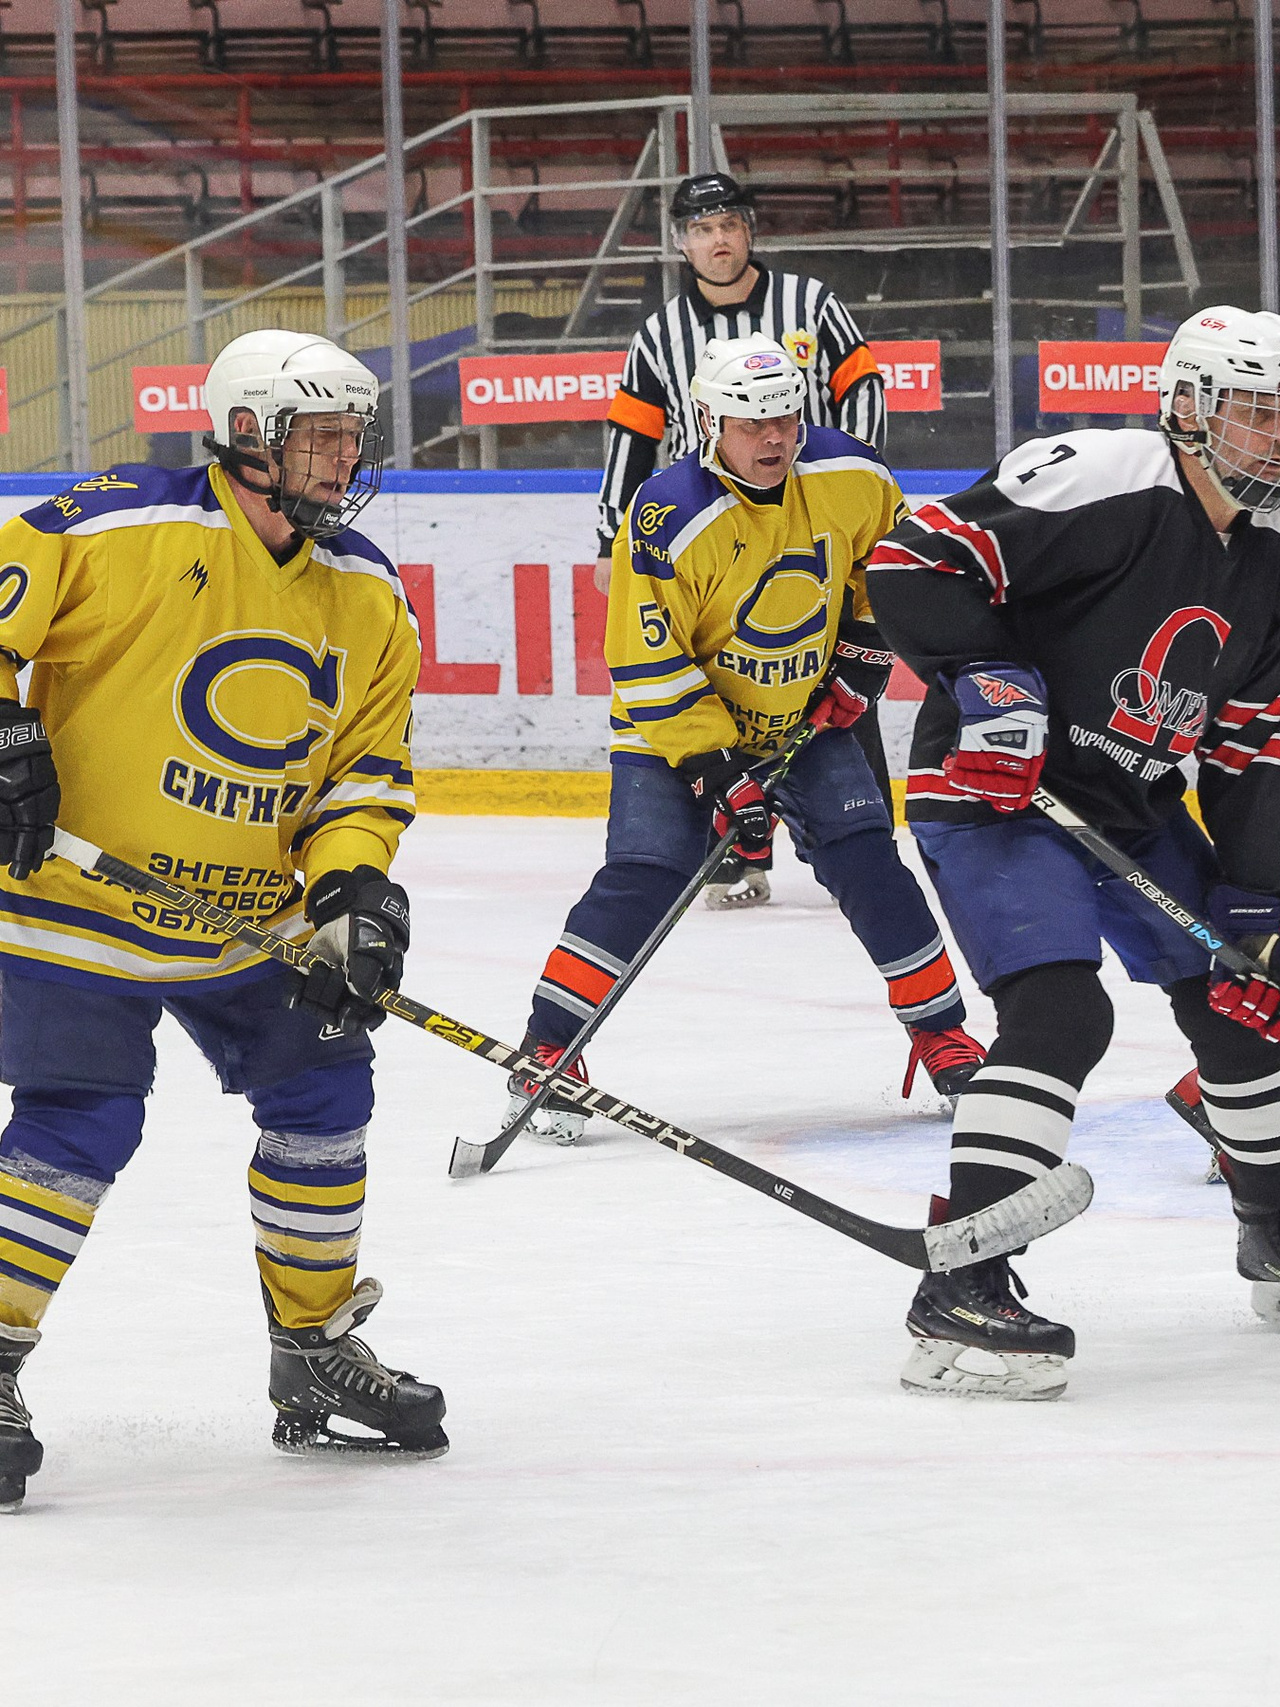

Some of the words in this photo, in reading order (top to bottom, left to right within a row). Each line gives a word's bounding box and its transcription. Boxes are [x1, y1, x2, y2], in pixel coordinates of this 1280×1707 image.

[1044, 364, 1161, 392] OLIMPB
[1176, 360, 1202, 372] CCM
[345, 384, 372, 396] Reebok
[466, 372, 621, 405] OLIMPBE
[763, 391, 788, 400] CCM
[715, 645, 828, 687] СИГНА
[1069, 725, 1143, 772] ОХРАННОЕ
[1126, 871, 1196, 928] NEXUS
